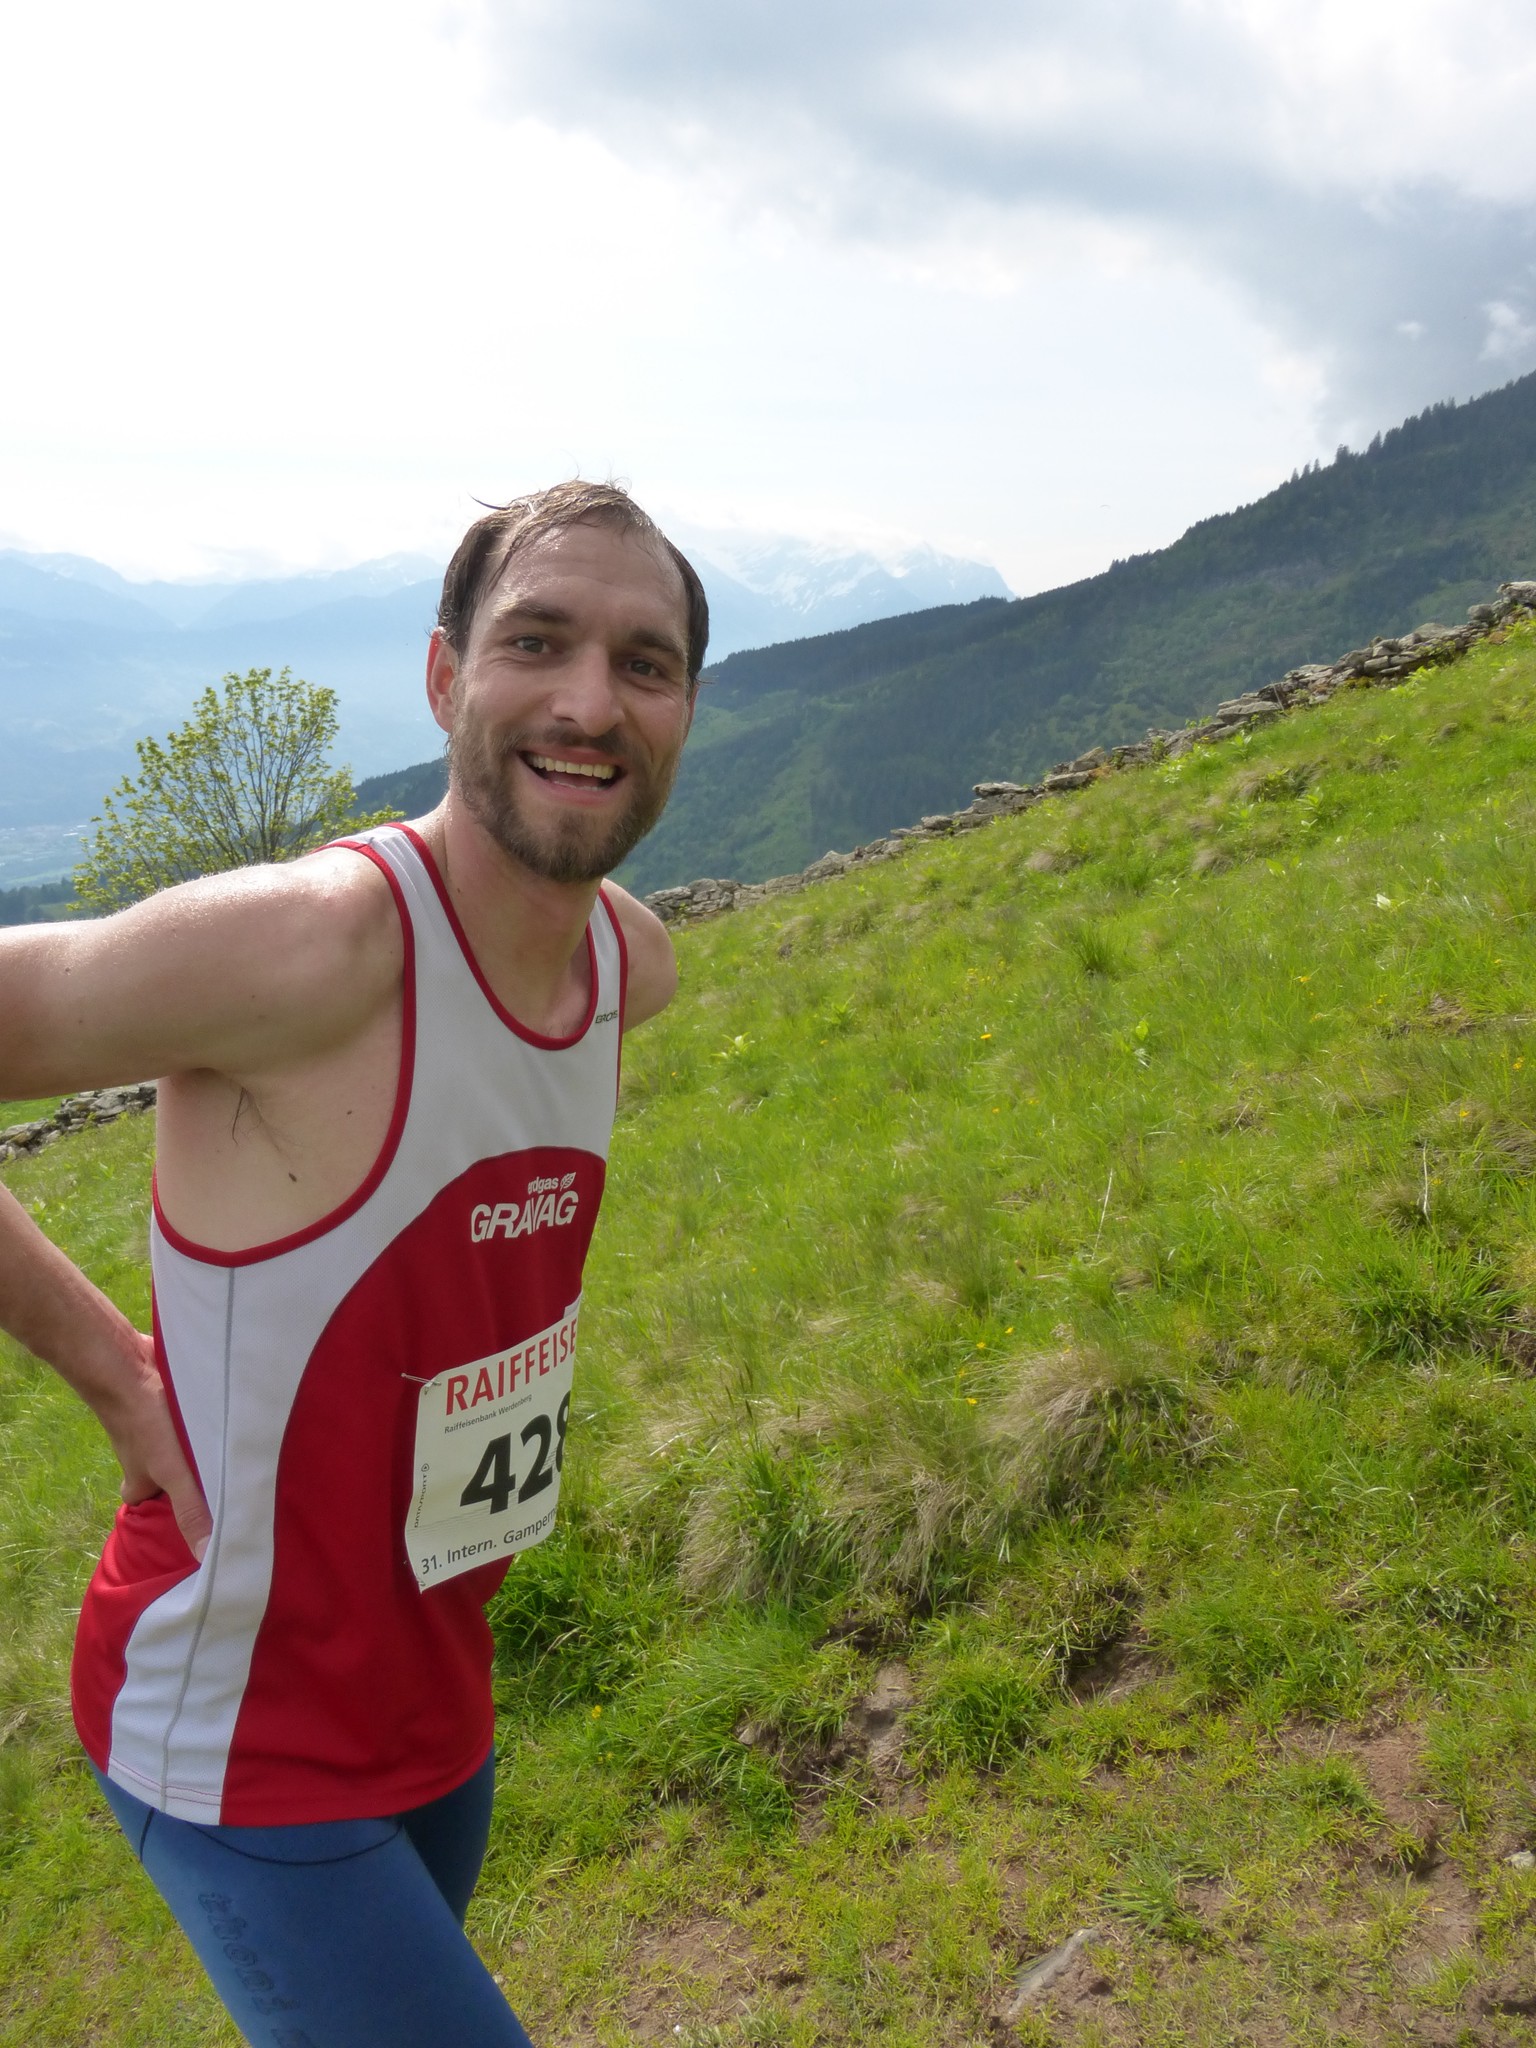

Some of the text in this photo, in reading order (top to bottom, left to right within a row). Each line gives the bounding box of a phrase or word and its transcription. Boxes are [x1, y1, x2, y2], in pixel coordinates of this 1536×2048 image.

[527, 1176, 558, 1195] erdgas
[471, 1190, 579, 1243] GRAVAG
[446, 1318, 577, 1416] RAIFFEISE
[445, 1394, 532, 1434] Raiffeisenbank Werdenberg
[421, 1505, 557, 1575] 31. Intern. Gampern
